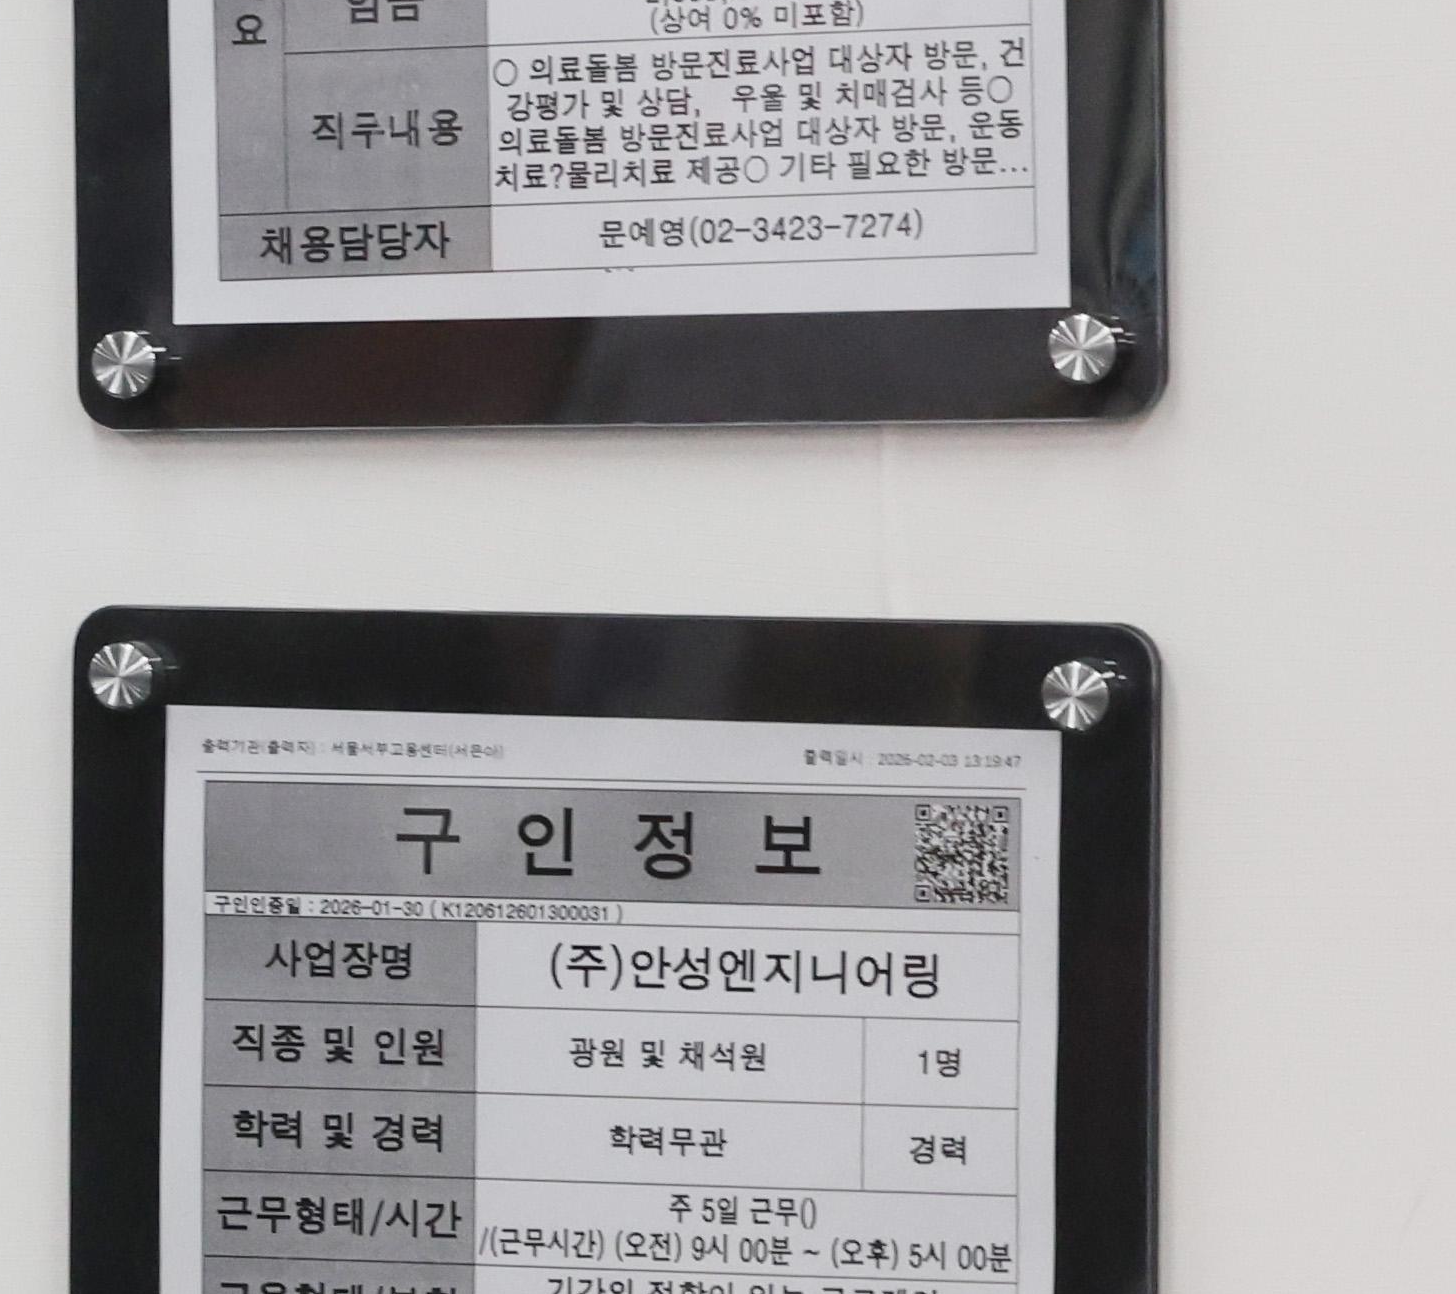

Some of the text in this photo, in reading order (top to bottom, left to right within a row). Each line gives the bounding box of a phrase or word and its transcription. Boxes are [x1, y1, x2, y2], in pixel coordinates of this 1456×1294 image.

[650, 0, 864, 35] (상여 0% 미포함)
[598, 208, 923, 249] 문예영(02-3423-7274)
[550, 942, 939, 999] (주)안성엔지니어링
[569, 1037, 766, 1072] 광원 및 채석원
[668, 1193, 817, 1229] 주 5일 근무()
